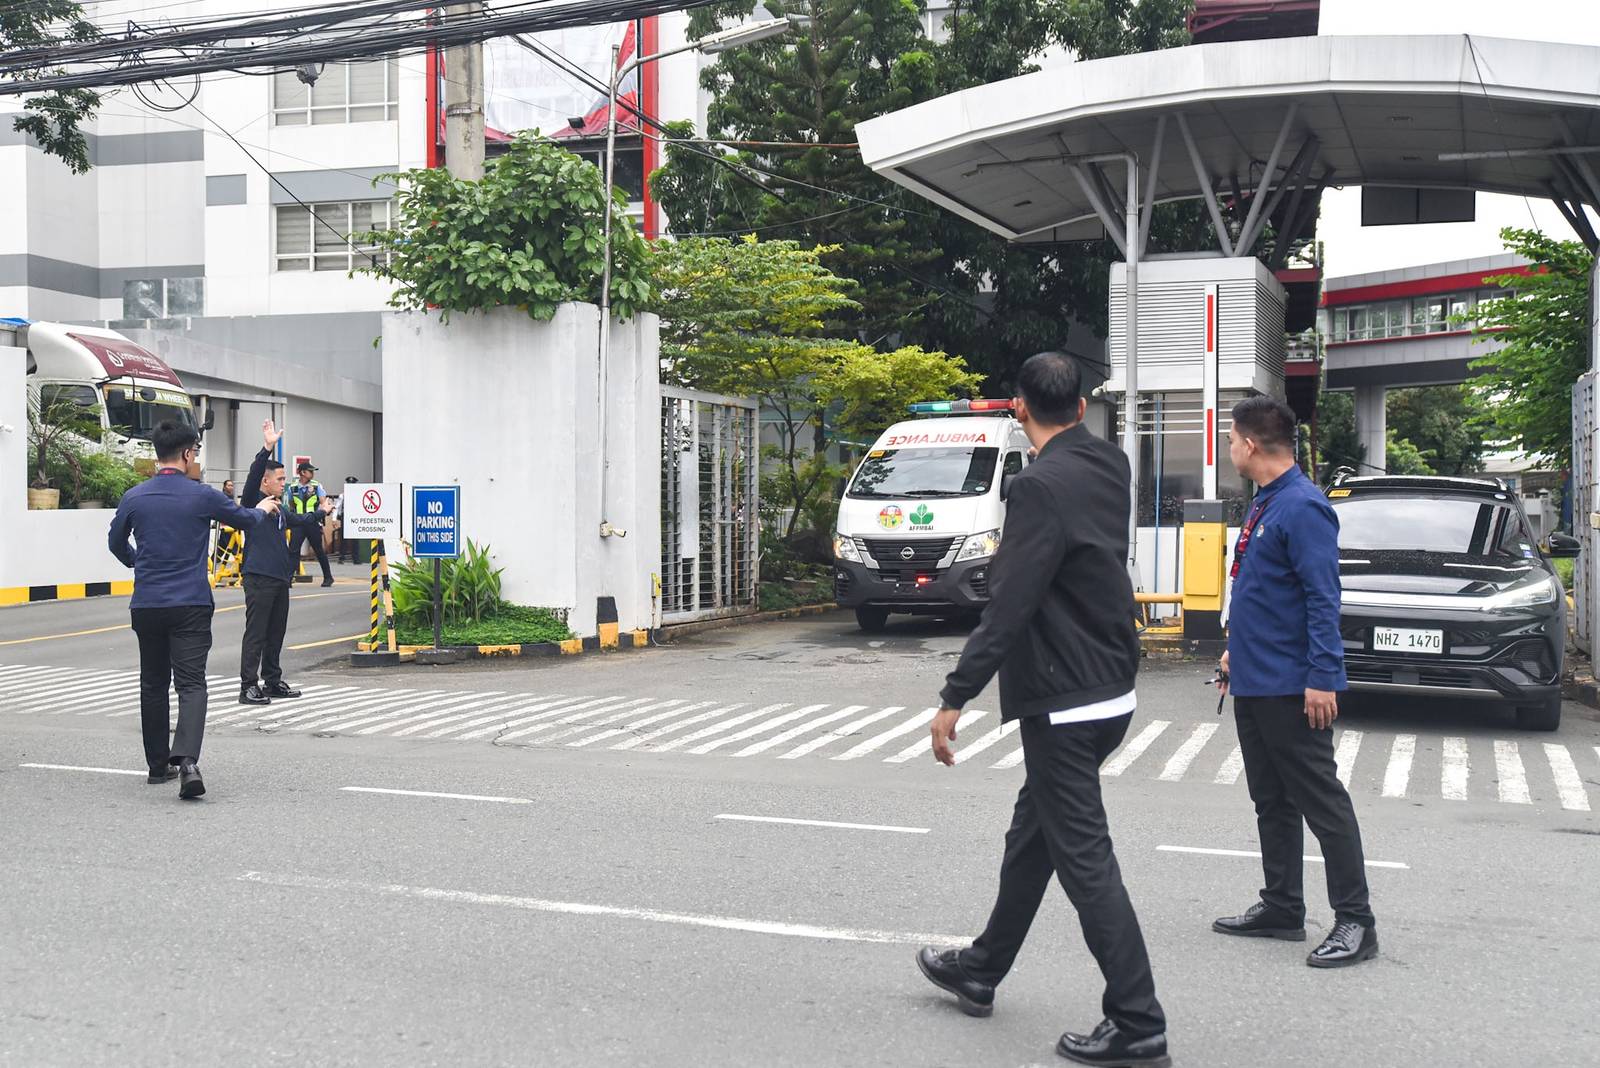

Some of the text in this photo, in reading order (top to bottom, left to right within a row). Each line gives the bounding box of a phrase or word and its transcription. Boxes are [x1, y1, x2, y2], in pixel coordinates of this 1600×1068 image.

[427, 501, 443, 513] NO
[416, 516, 454, 529] PARKING
[417, 532, 454, 543] ON THIS SIDE
[1376, 632, 1440, 648] NHZ 1470
